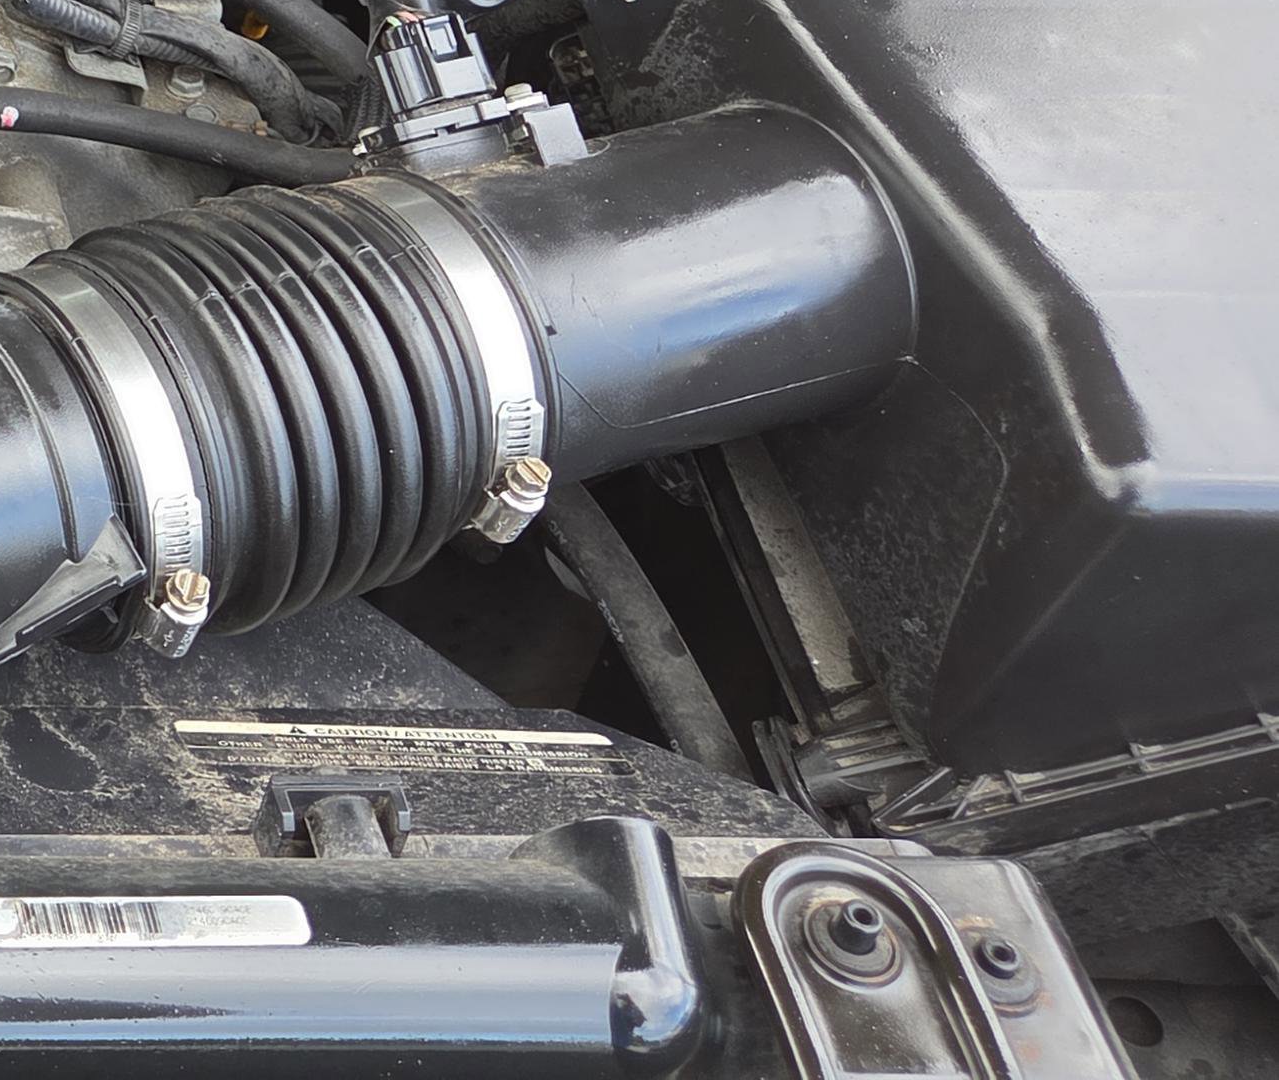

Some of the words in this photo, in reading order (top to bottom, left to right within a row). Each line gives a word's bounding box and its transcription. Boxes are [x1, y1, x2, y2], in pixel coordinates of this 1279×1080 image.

[314, 727, 390, 737] CAUTION
[404, 730, 498, 740] ATTENTION
[355, 738, 404, 746] NISSAN
